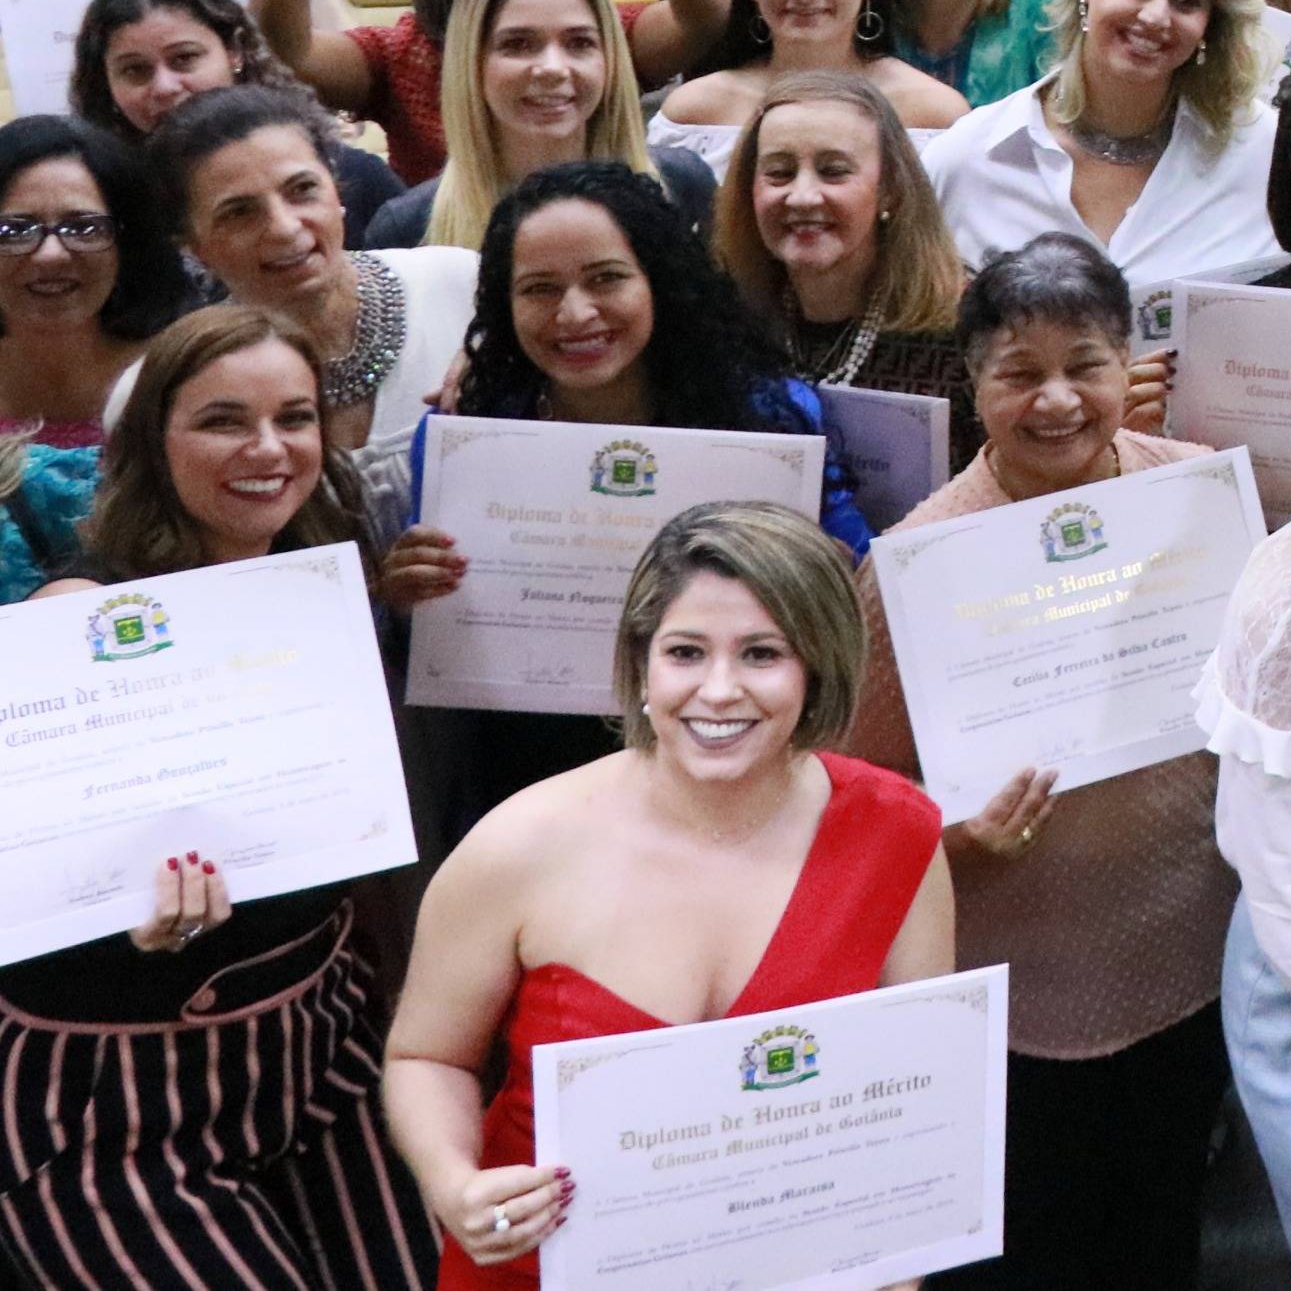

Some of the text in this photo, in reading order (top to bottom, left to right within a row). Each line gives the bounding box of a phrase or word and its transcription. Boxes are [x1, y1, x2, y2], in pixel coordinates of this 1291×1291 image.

[1224, 360, 1290, 381] Diploma
[485, 501, 562, 526] Diploma
[568, 505, 590, 525] de
[509, 530, 569, 550] Câmara
[1035, 563, 1142, 603] de Honra ao
[1043, 589, 1131, 626] Municipal de
[1053, 632, 1189, 680] Ferreira da Silva Castro
[74, 665, 217, 707] de Honra ao
[4, 694, 200, 749] Câmara Municipal de
[81, 758, 229, 803] Fernanda Gonçalves
[618, 1070, 932, 1152] Diploma de Honra ao Mérito
[650, 1103, 903, 1172] Câmara Municipal de Goiânia
